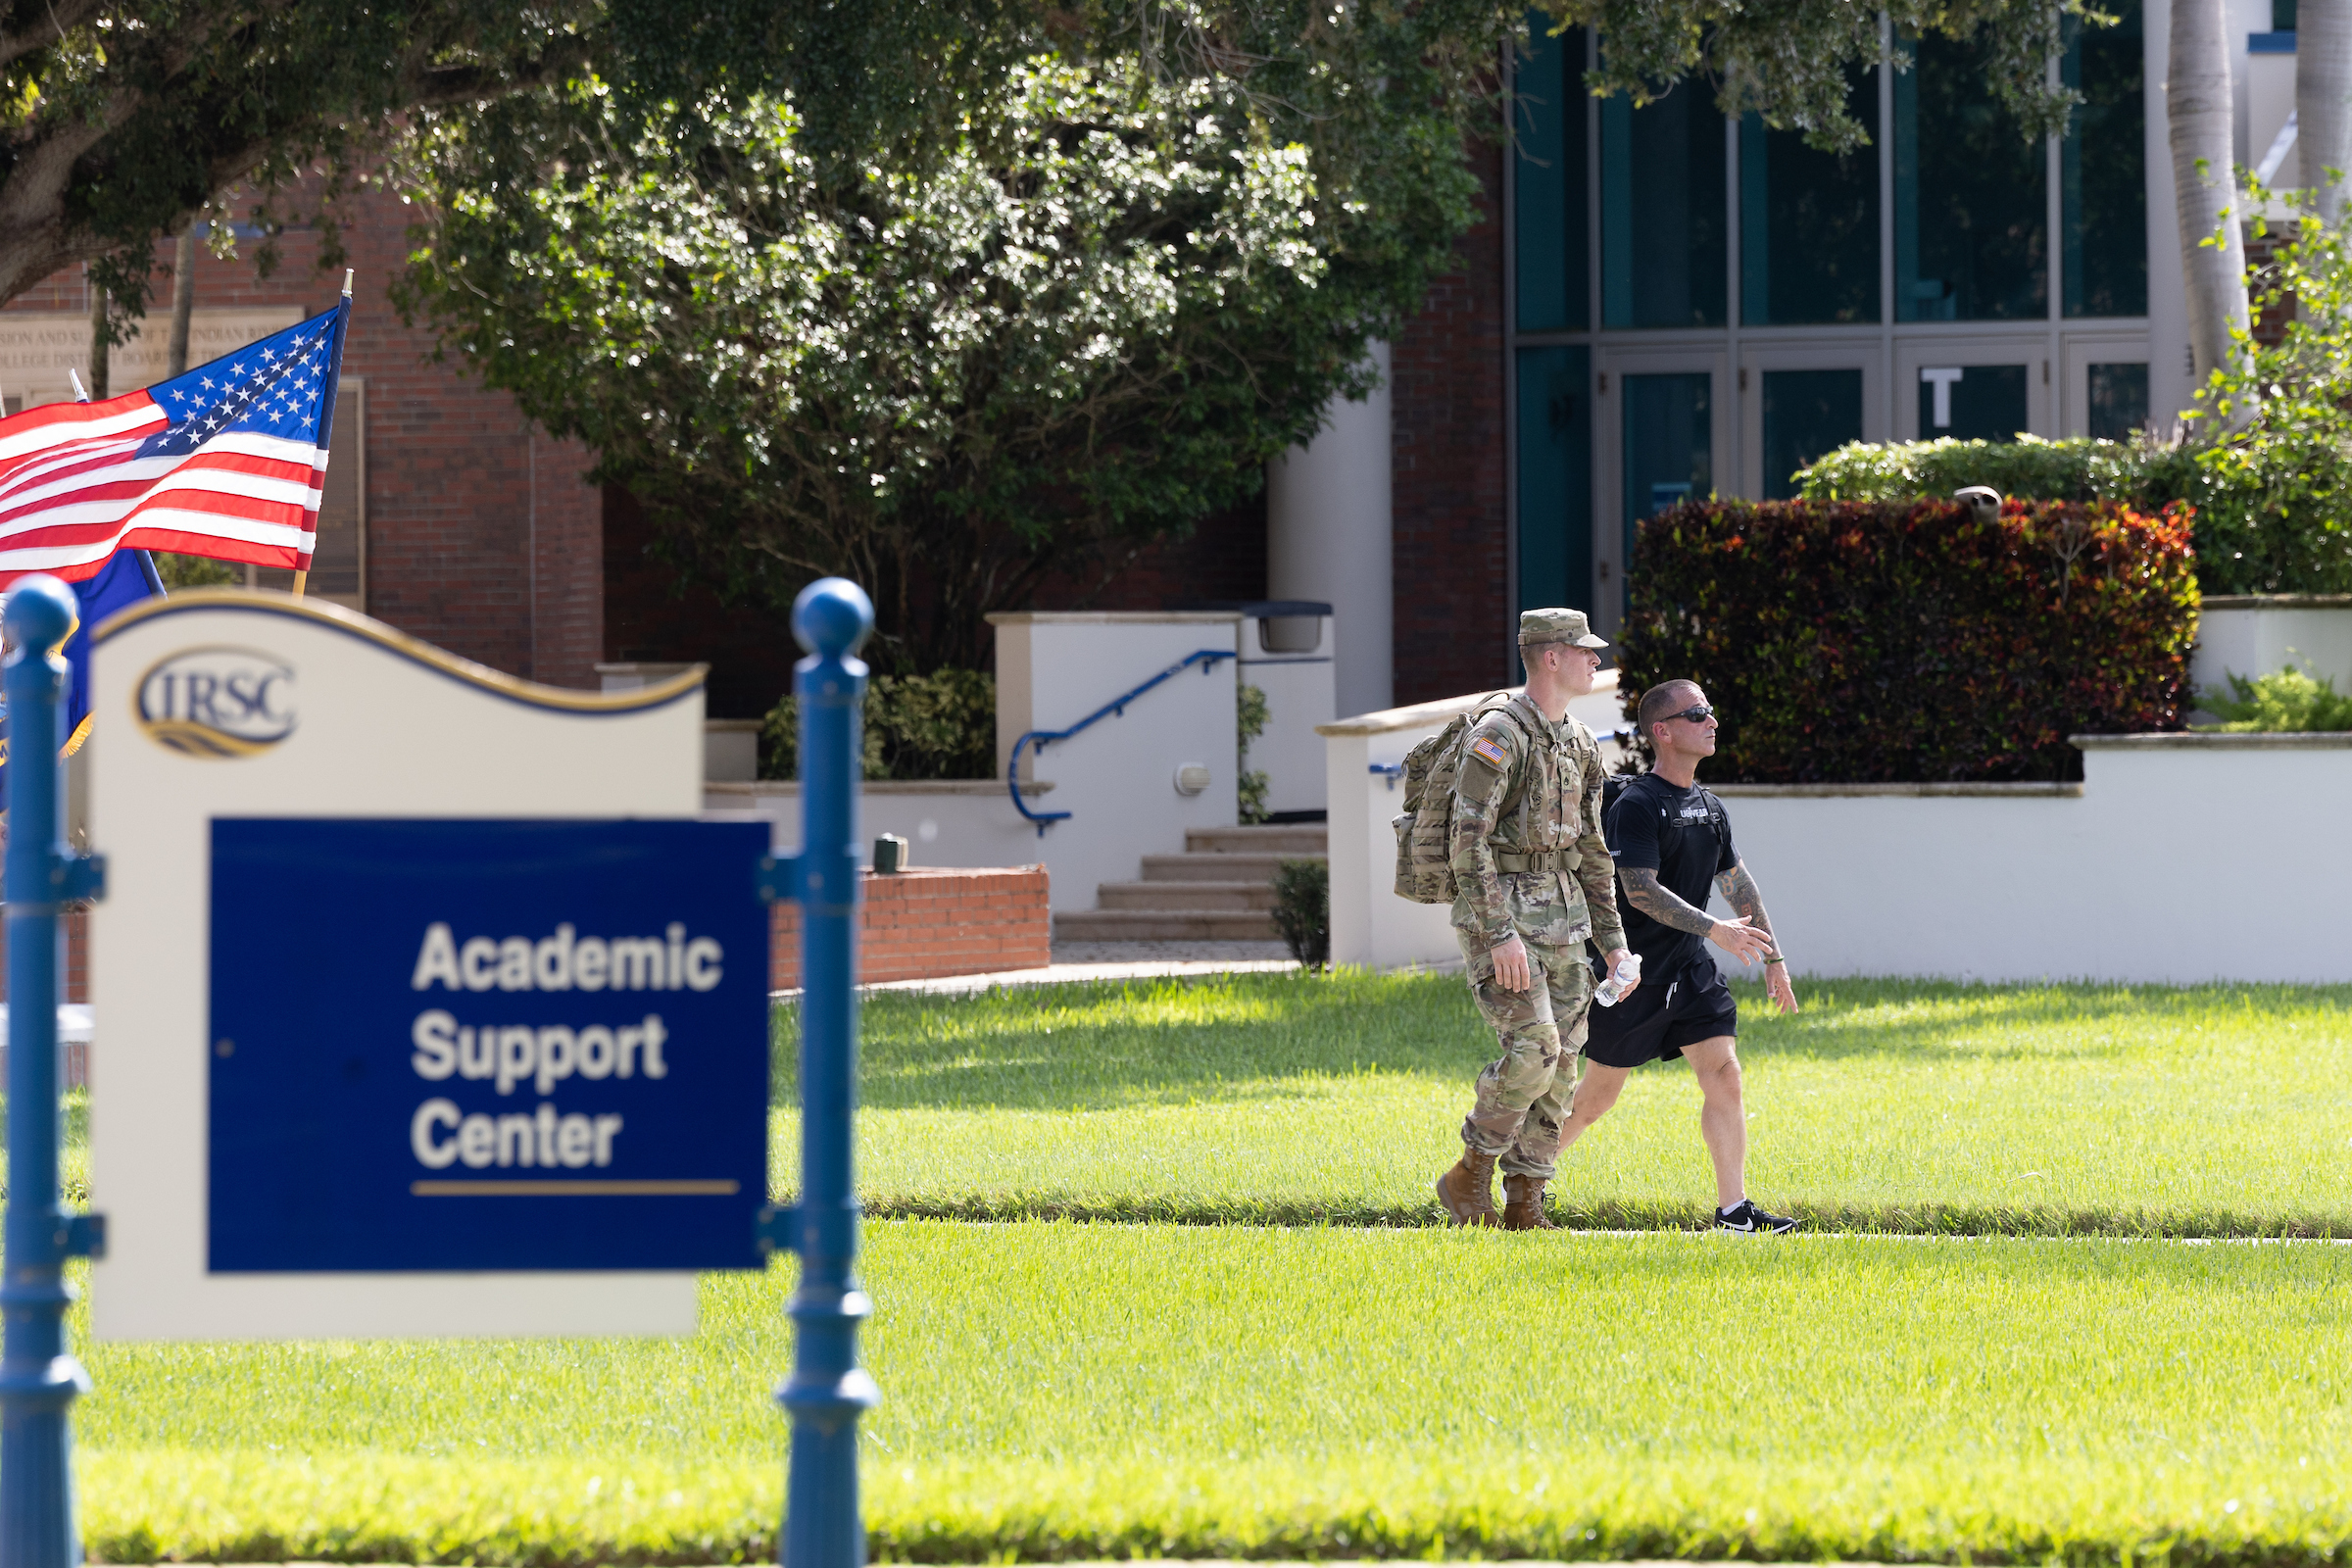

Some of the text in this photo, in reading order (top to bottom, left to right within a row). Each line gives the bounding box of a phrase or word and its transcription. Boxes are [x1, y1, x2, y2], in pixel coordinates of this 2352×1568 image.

[35, 329, 68, 346] AND
[1921, 368, 1963, 427] T
[164, 666, 297, 727] IRSC
[412, 921, 724, 992] Academic
[411, 1008, 668, 1096] Support
[411, 1097, 624, 1169] Center
